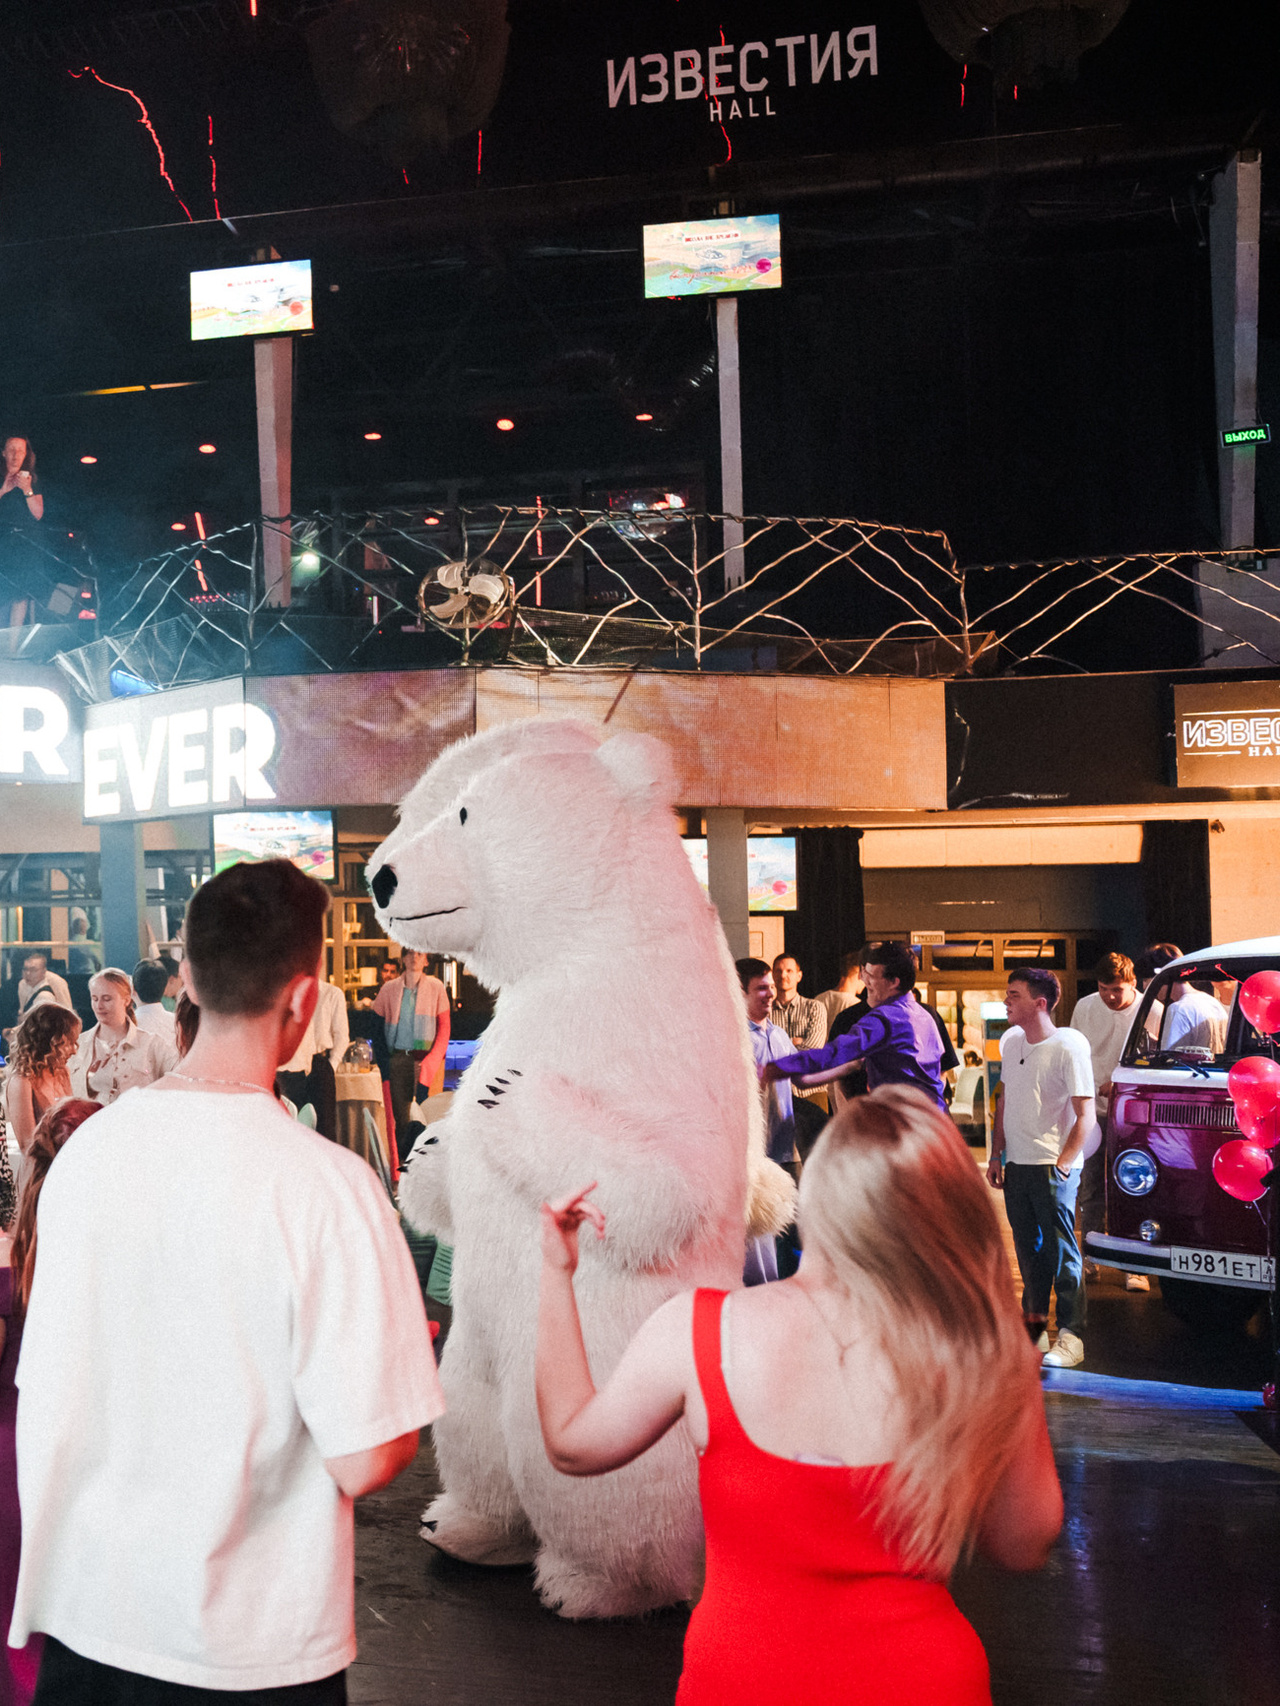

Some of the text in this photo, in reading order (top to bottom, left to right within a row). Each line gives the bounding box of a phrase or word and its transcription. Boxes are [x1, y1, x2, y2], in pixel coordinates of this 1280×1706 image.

[607, 25, 878, 108] ИЗВЕСТИЯ
[710, 96, 776, 122] HALL
[1225, 429, 1266, 443] ВЫХОД
